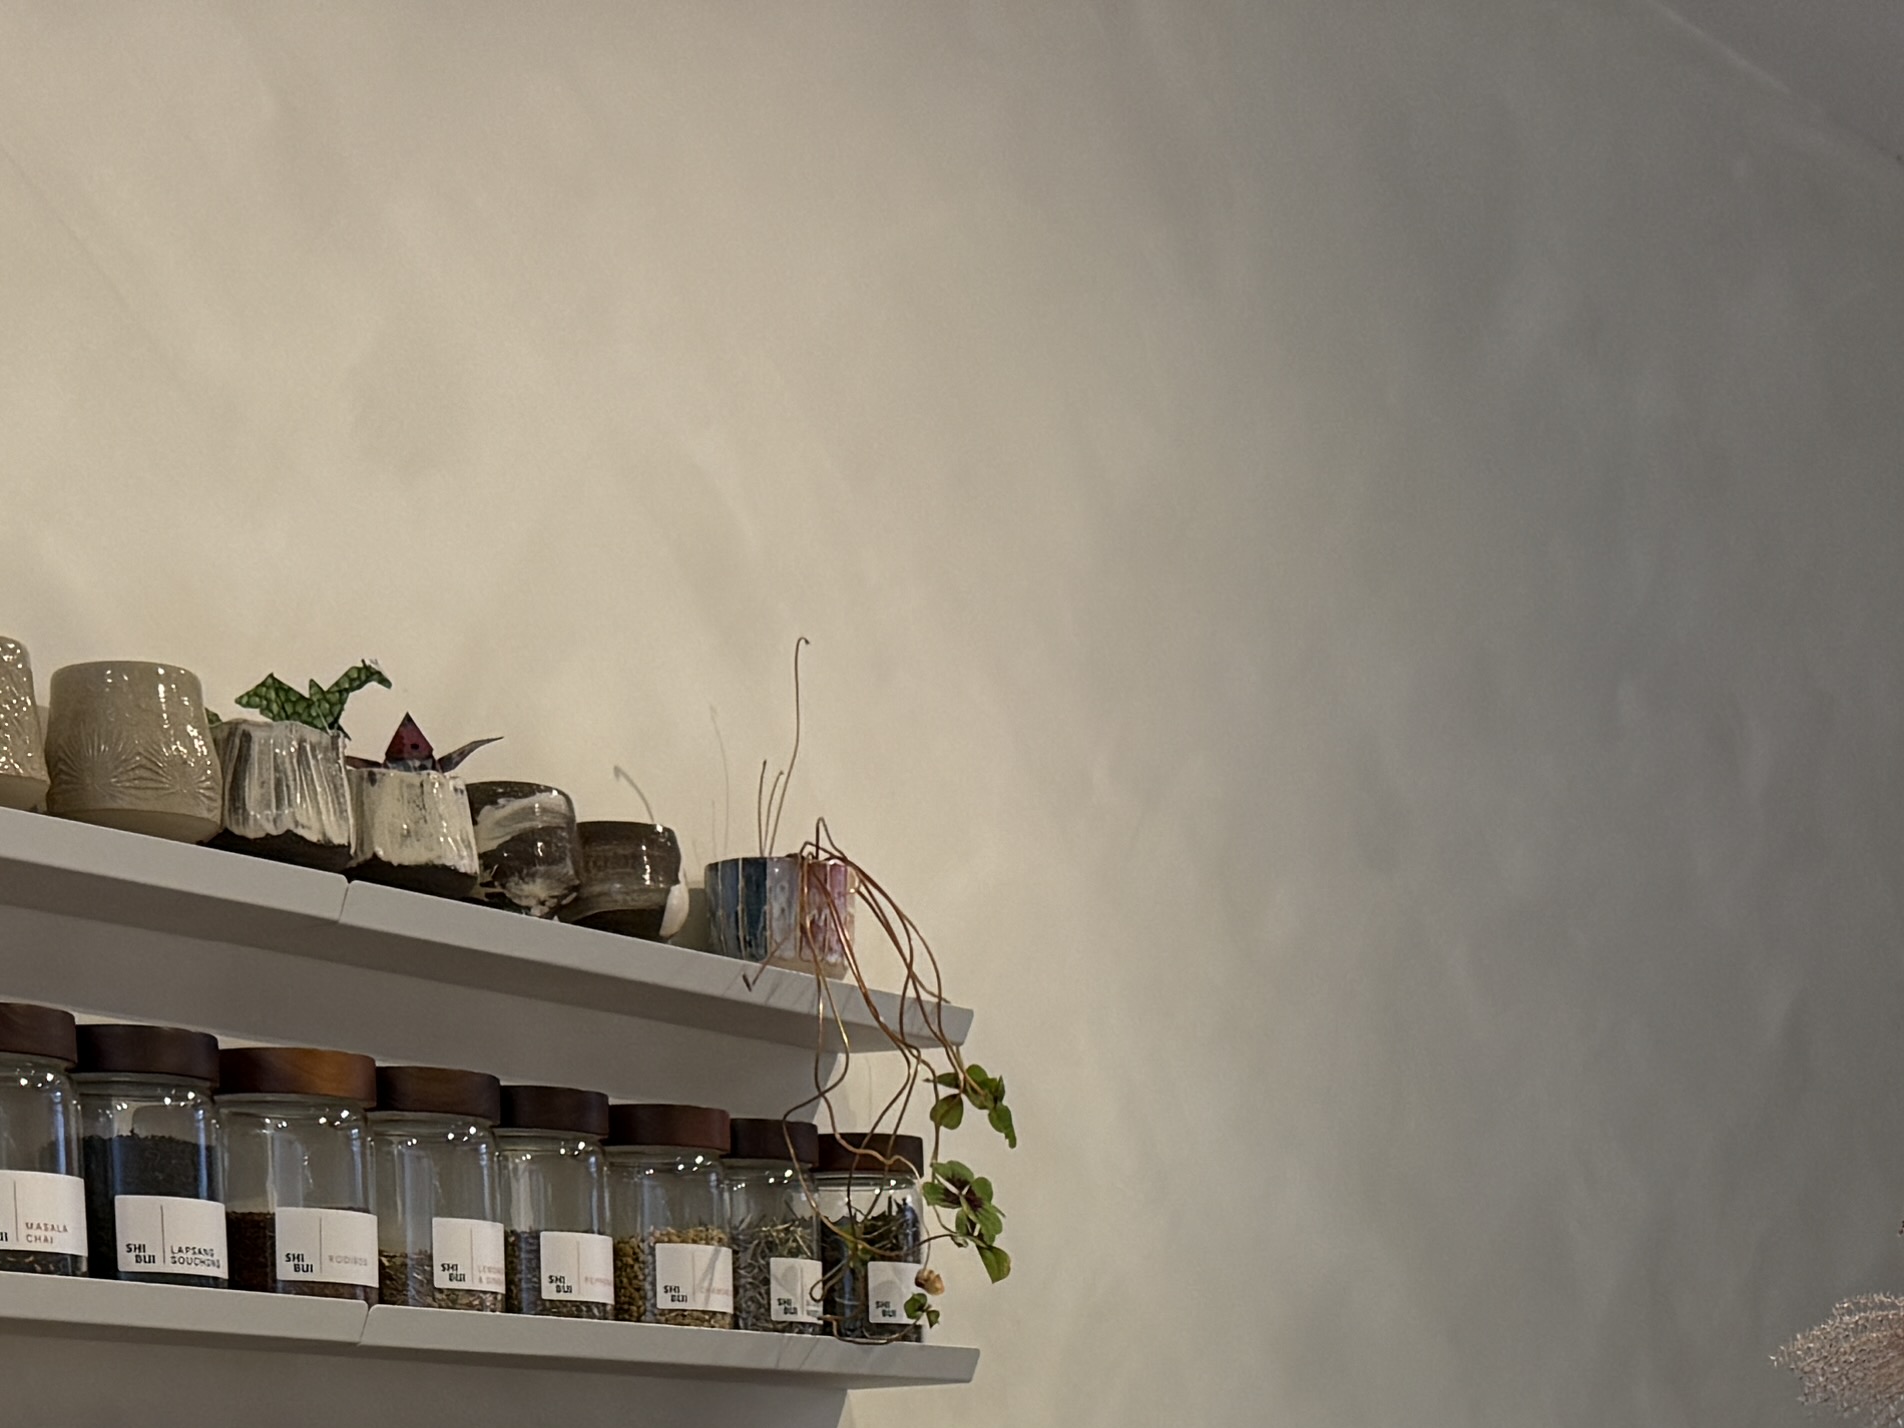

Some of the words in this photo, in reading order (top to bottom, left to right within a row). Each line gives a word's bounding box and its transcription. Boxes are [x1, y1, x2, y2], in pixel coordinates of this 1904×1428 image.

[24, 1221, 69, 1233] MASALA
[25, 1233, 54, 1244] CHAI
[125, 1242, 146, 1253] SHI
[134, 1254, 156, 1264] BUI
[284, 1252, 305, 1263] SHI
[293, 1263, 313, 1273] BUI
[440, 1262, 458, 1272] SHI
[448, 1272, 466, 1282] BUI
